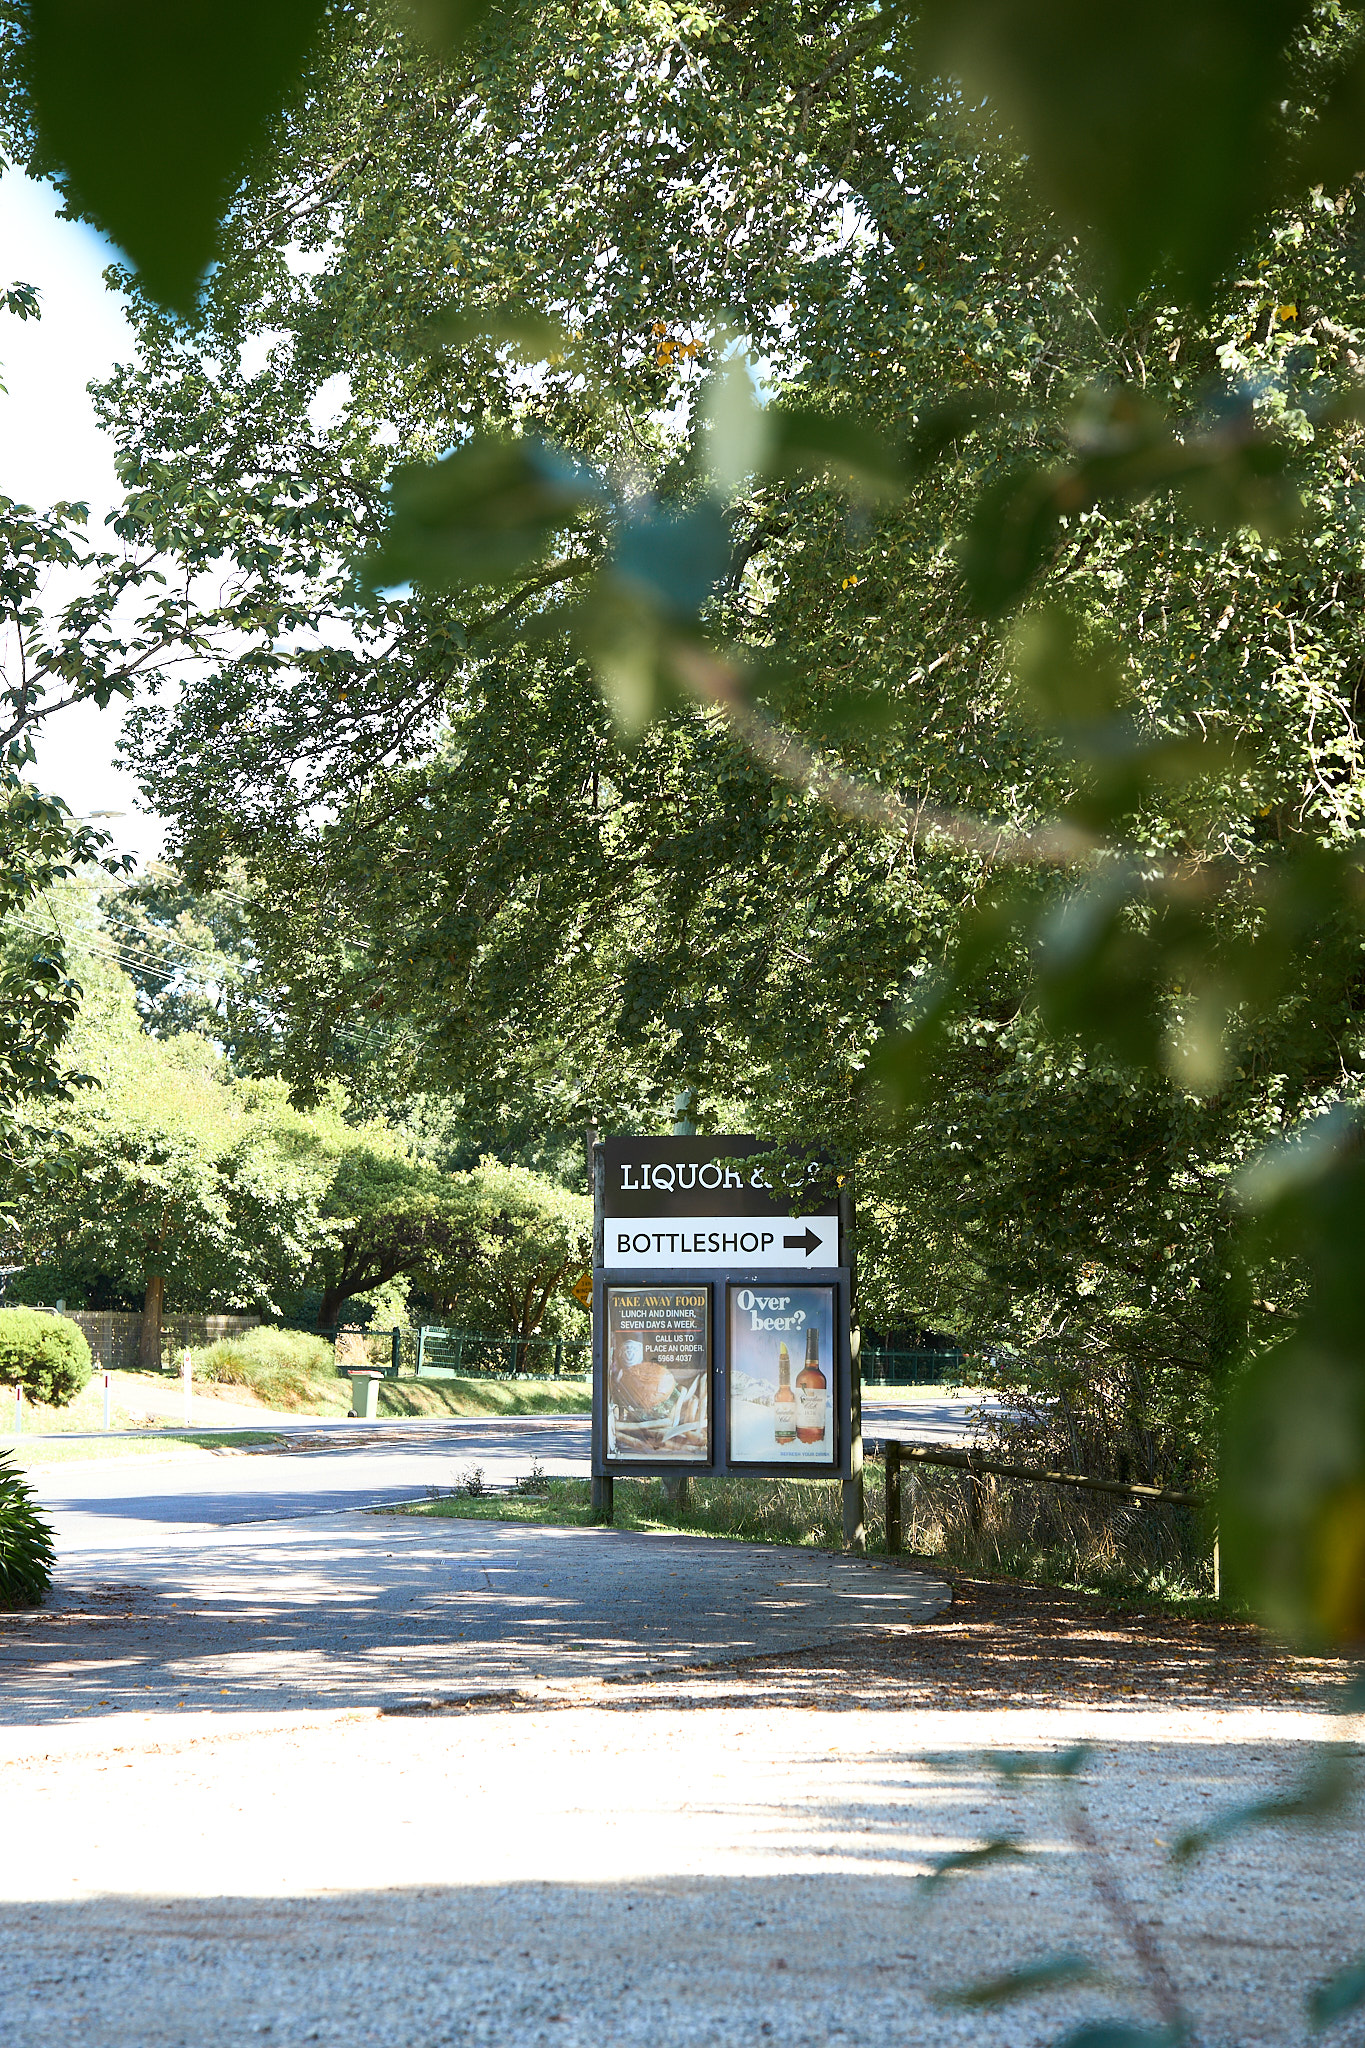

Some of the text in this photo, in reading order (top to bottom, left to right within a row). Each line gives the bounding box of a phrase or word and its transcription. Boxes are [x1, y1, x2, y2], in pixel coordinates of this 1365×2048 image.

[620, 1163, 744, 1192] LIQUOR
[617, 1232, 774, 1253] BOTTLESHOP
[612, 1296, 705, 1307] TAKE AWAY FOOD
[737, 1289, 790, 1311] Over
[621, 1309, 697, 1318] LUNCH AND DINNER,
[620, 1320, 698, 1329] SEVEN DAYS A WEEK.
[750, 1310, 807, 1331] beer?
[645, 1345, 667, 1353] PLACE
[679, 1344, 705, 1352] ORDER.
[657, 1354, 693, 1362] 5968 4037
